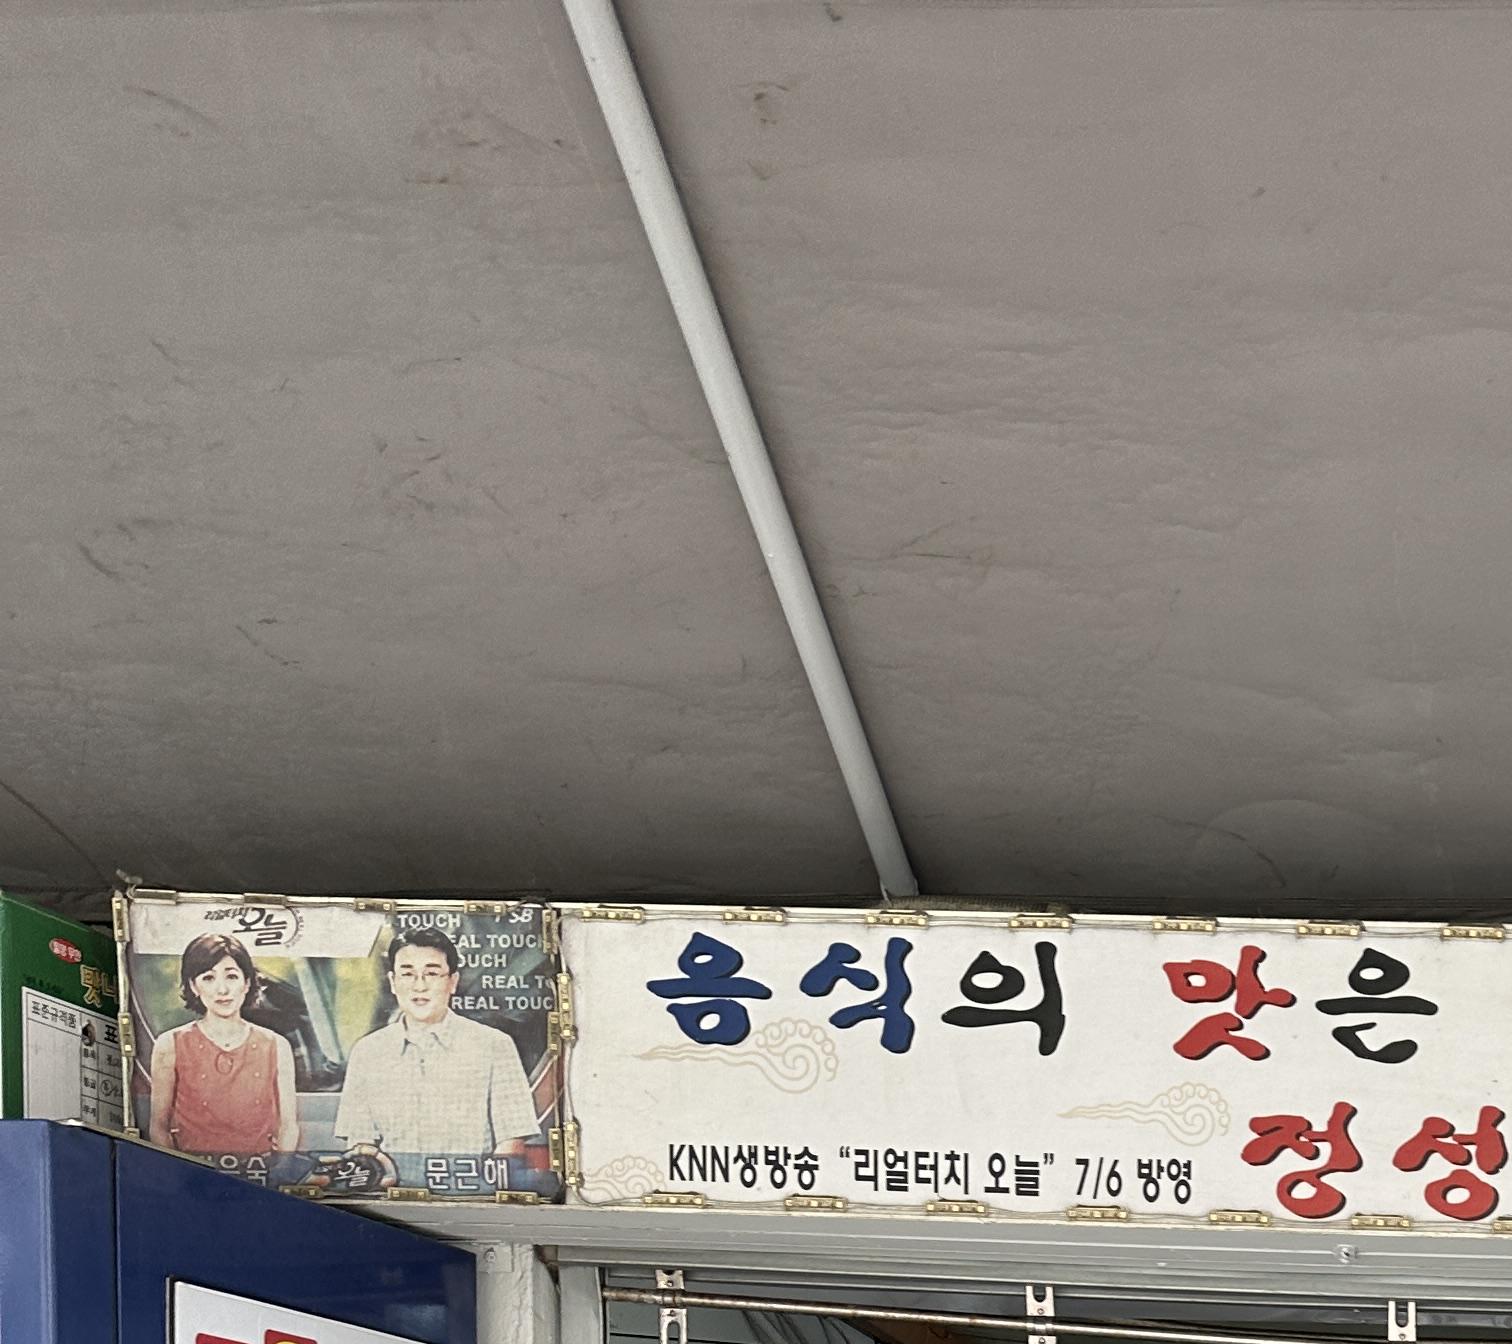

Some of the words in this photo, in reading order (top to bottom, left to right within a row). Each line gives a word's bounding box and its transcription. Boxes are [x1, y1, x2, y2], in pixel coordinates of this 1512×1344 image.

[400, 912, 462, 929] TOUCH
[482, 974, 529, 990] REAL
[452, 996, 499, 1011] REAL
[646, 931, 1067, 1057] 음식의
[1162, 944, 1439, 1064] 맛은
[425, 1157, 509, 1192] 문근해
[668, 1143, 820, 1192] KNN생방송
[1074, 1157, 1123, 1198] 7/6
[1136, 1158, 1195, 1204] 방영
